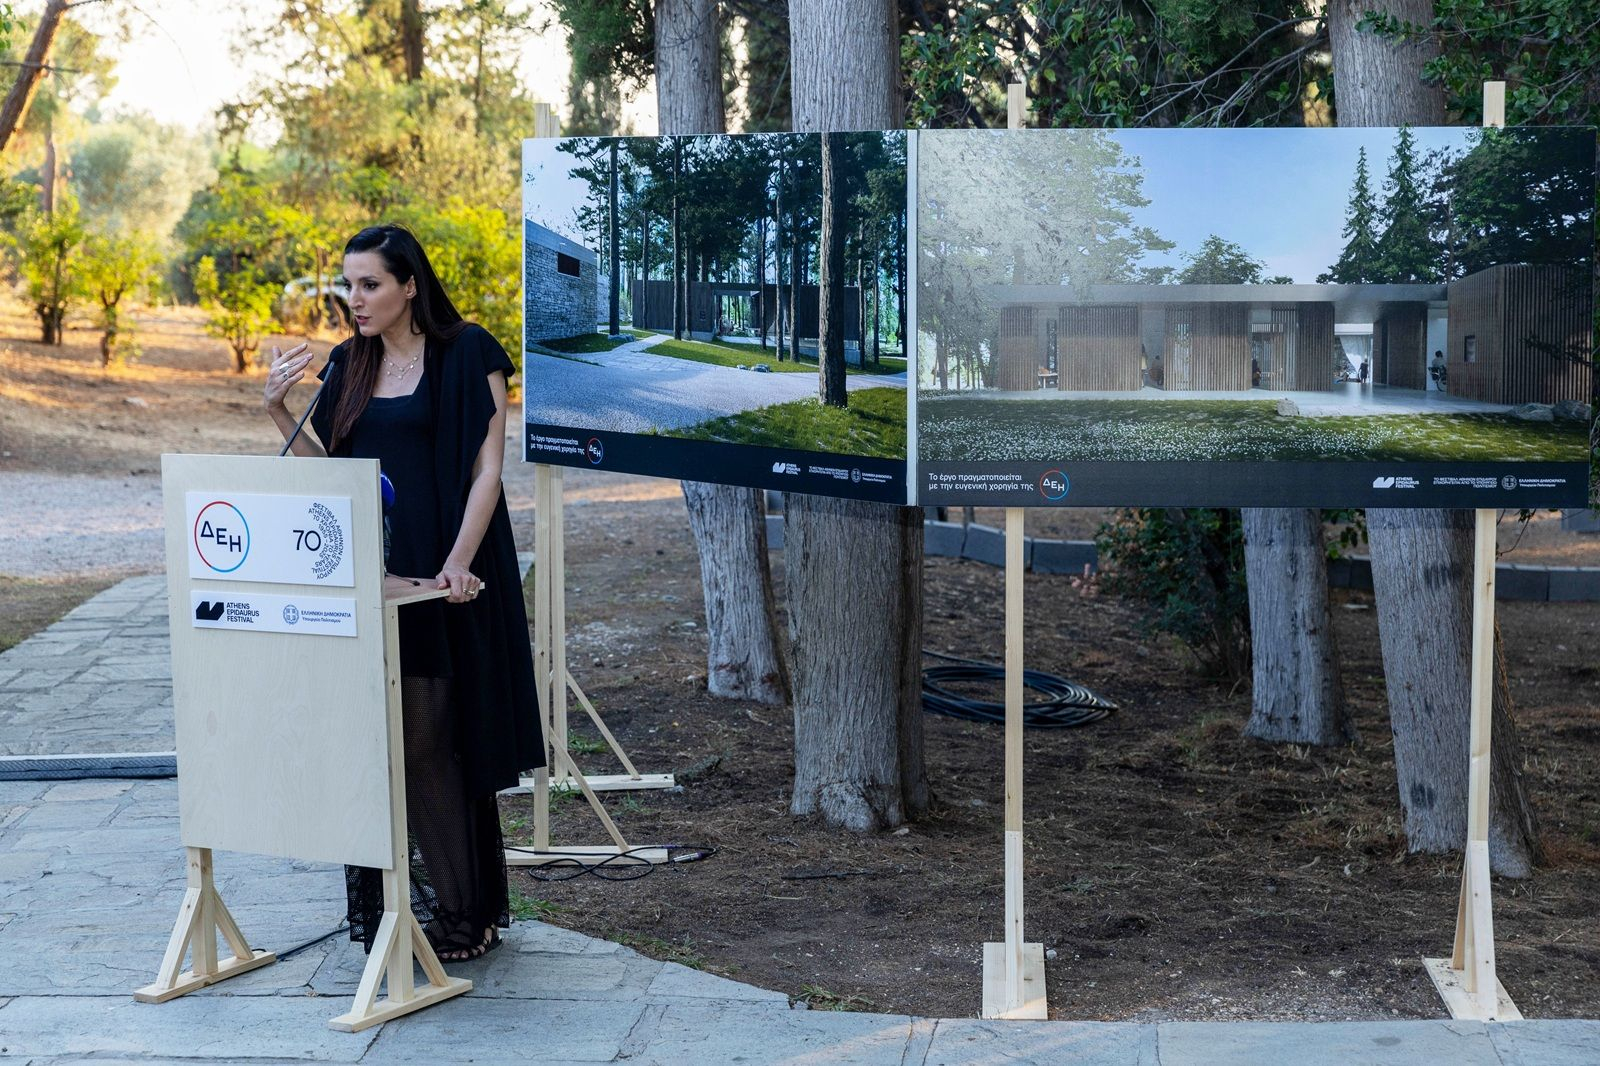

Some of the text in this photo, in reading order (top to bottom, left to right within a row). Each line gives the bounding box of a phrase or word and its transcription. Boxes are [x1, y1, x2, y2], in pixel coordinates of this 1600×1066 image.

[589, 445, 601, 457] ΔΕΗ
[940, 473, 956, 482] έργο
[958, 473, 1022, 482] πραγματοποιείται
[955, 482, 987, 491] ευγενική
[989, 482, 1018, 491] χορηγία
[1043, 478, 1065, 491] ΔΕΗ
[308, 508, 329, 522] ATHENS
[200, 521, 242, 552] ΔΕΗ
[293, 530, 321, 551] 70
